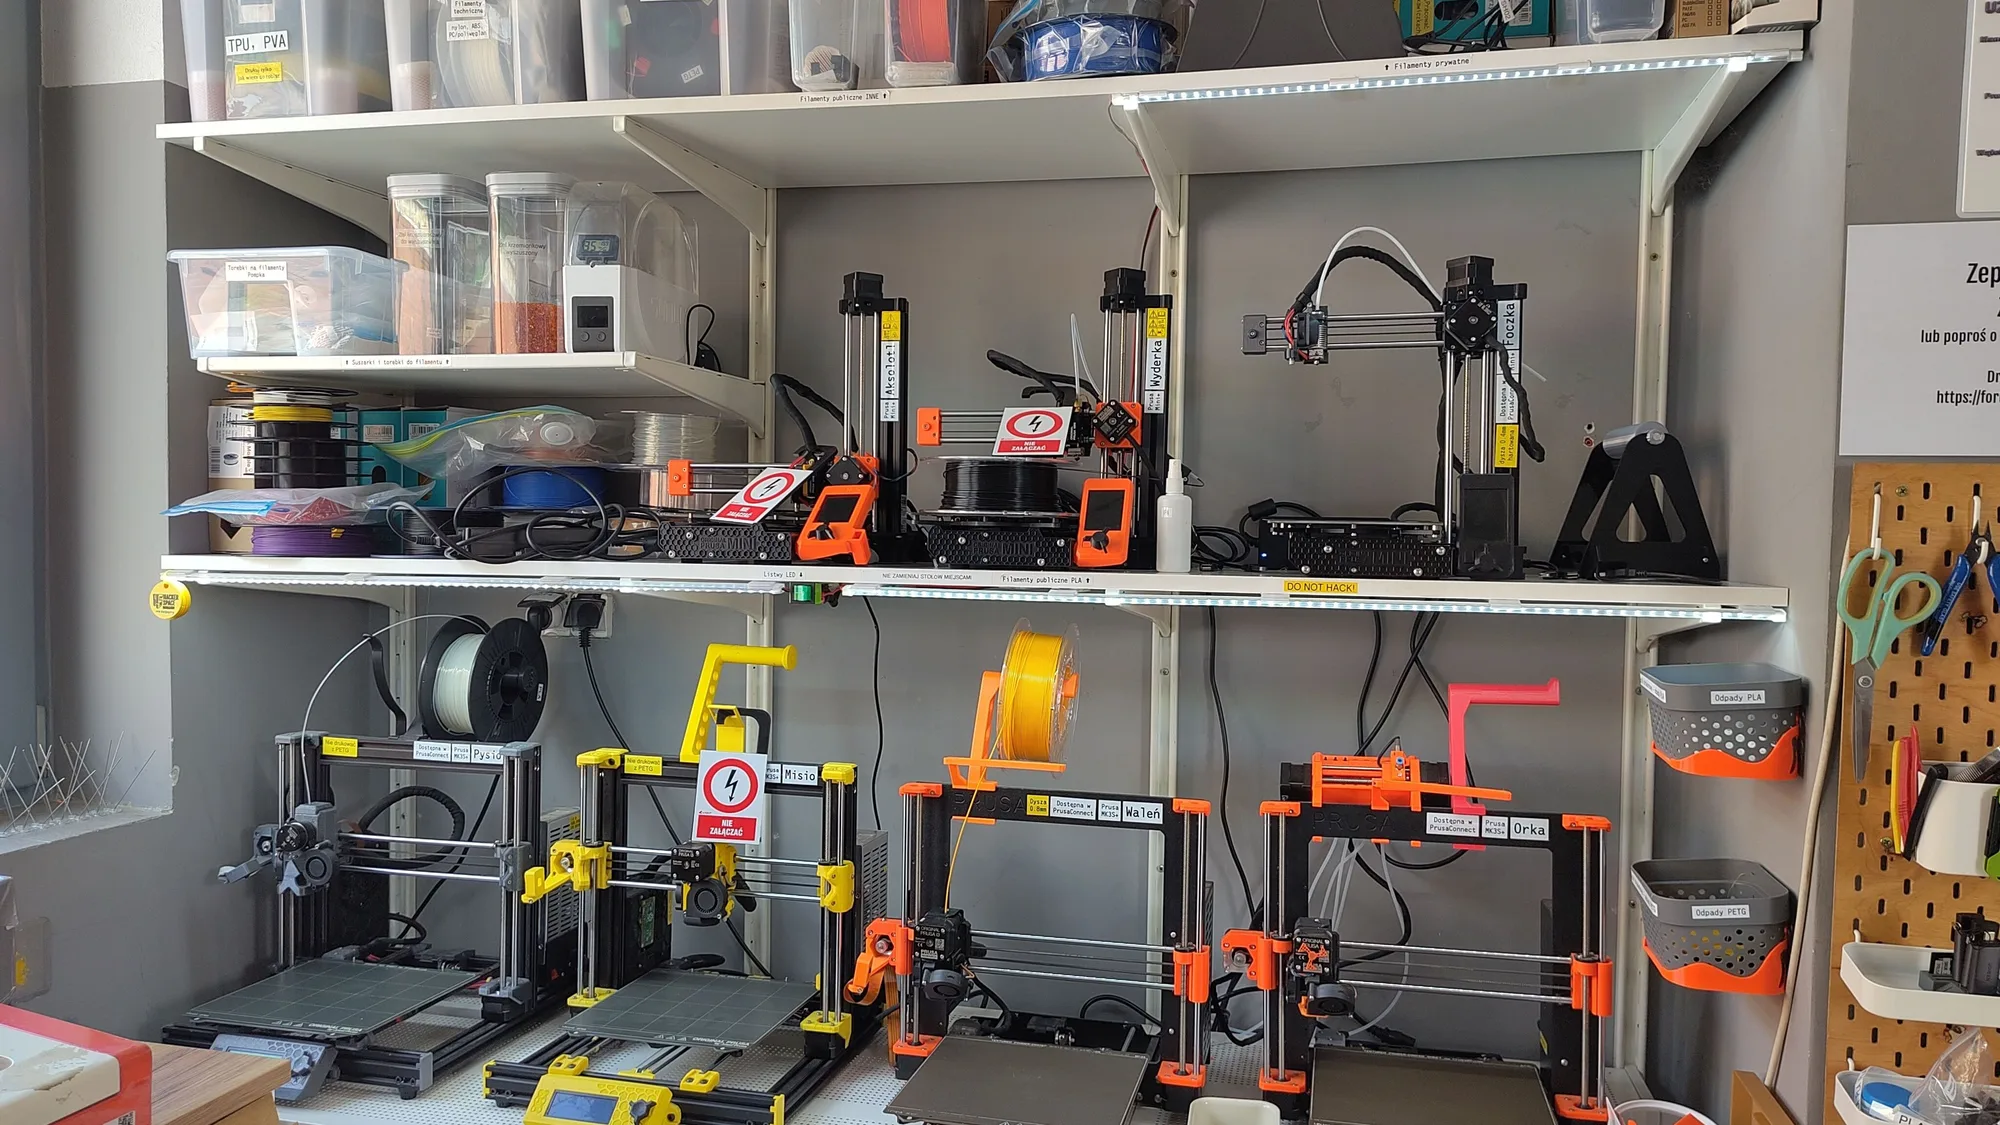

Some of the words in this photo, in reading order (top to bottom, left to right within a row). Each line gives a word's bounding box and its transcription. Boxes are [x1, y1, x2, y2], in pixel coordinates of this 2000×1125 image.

[228, 37, 255, 52] TPU,
[263, 34, 286, 49] PVA
[1394, 61, 1432, 70] Filamenty
[1435, 58, 1469, 68] prywatne
[1502, 303, 1515, 346] Foczka
[1921, 329, 1940, 343] lub
[1944, 328, 1986, 345] poproś
[1990, 331, 1997, 342] o
[1150, 340, 1162, 387] Wyderka
[885, 344, 895, 396] Aksolotl
[1507, 387, 1515, 421] PrusaConn
[728, 537, 757, 550] MINI
[1001, 542, 1034, 555] MINI
[763, 571, 783, 579] Listwy
[1287, 582, 1301, 591] DO
[1304, 583, 1323, 591] NOT
[1326, 584, 1355, 592] HACK!
[1715, 694, 1743, 702] Odpady
[1747, 693, 1762, 701] PLA
[416, 751, 449, 759] PrusaConnect
[473, 749, 502, 761] Pysio
[784, 769, 816, 781] Misio
[1056, 800, 1084, 808] Dostępna
[1101, 803, 1119, 811] Prusa
[1053, 807, 1094, 817] PrusaConnect
[1126, 806, 1160, 819] Waleń
[721, 819, 733, 827] NIE
[1434, 817, 1464, 825] Dostępna
[709, 827, 744, 837] ZAŁĄCZAĆ
[1429, 825, 1476, 833] PrusaConnect
[1514, 823, 1545, 835] Orka
[1696, 909, 1723, 917] Odpady
[1899, 1115, 1923, 1125] PL
